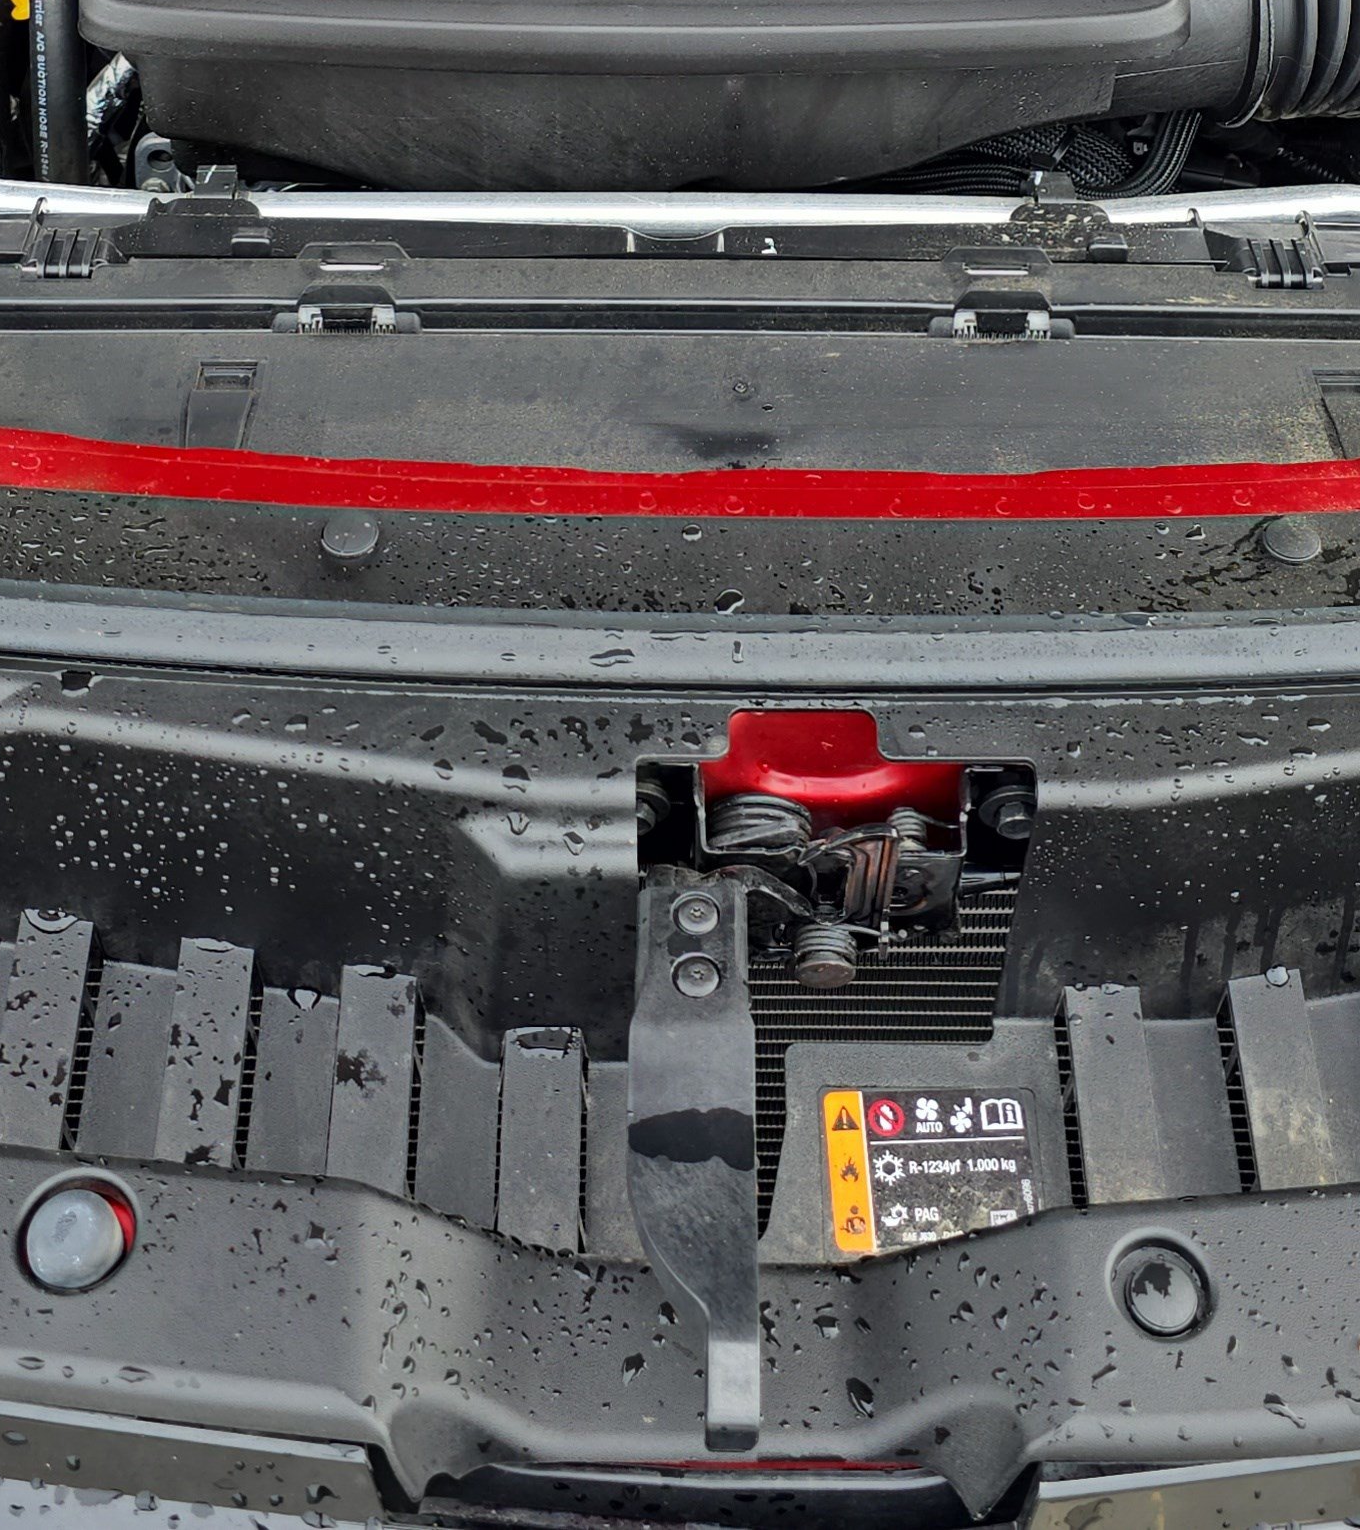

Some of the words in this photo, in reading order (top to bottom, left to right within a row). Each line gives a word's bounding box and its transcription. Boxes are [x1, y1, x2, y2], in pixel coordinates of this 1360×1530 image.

[36, 31, 45, 52] A/C
[37, 54, 47, 106] SUCTION
[39, 107, 48, 139] HOSE
[915, 1122, 943, 1134] AUTO
[909, 1159, 961, 1176] R-1234yf
[967, 1158, 998, 1172] 1.000
[1000, 1157, 1016, 1173] kg
[914, 1206, 940, 1222] PAG
